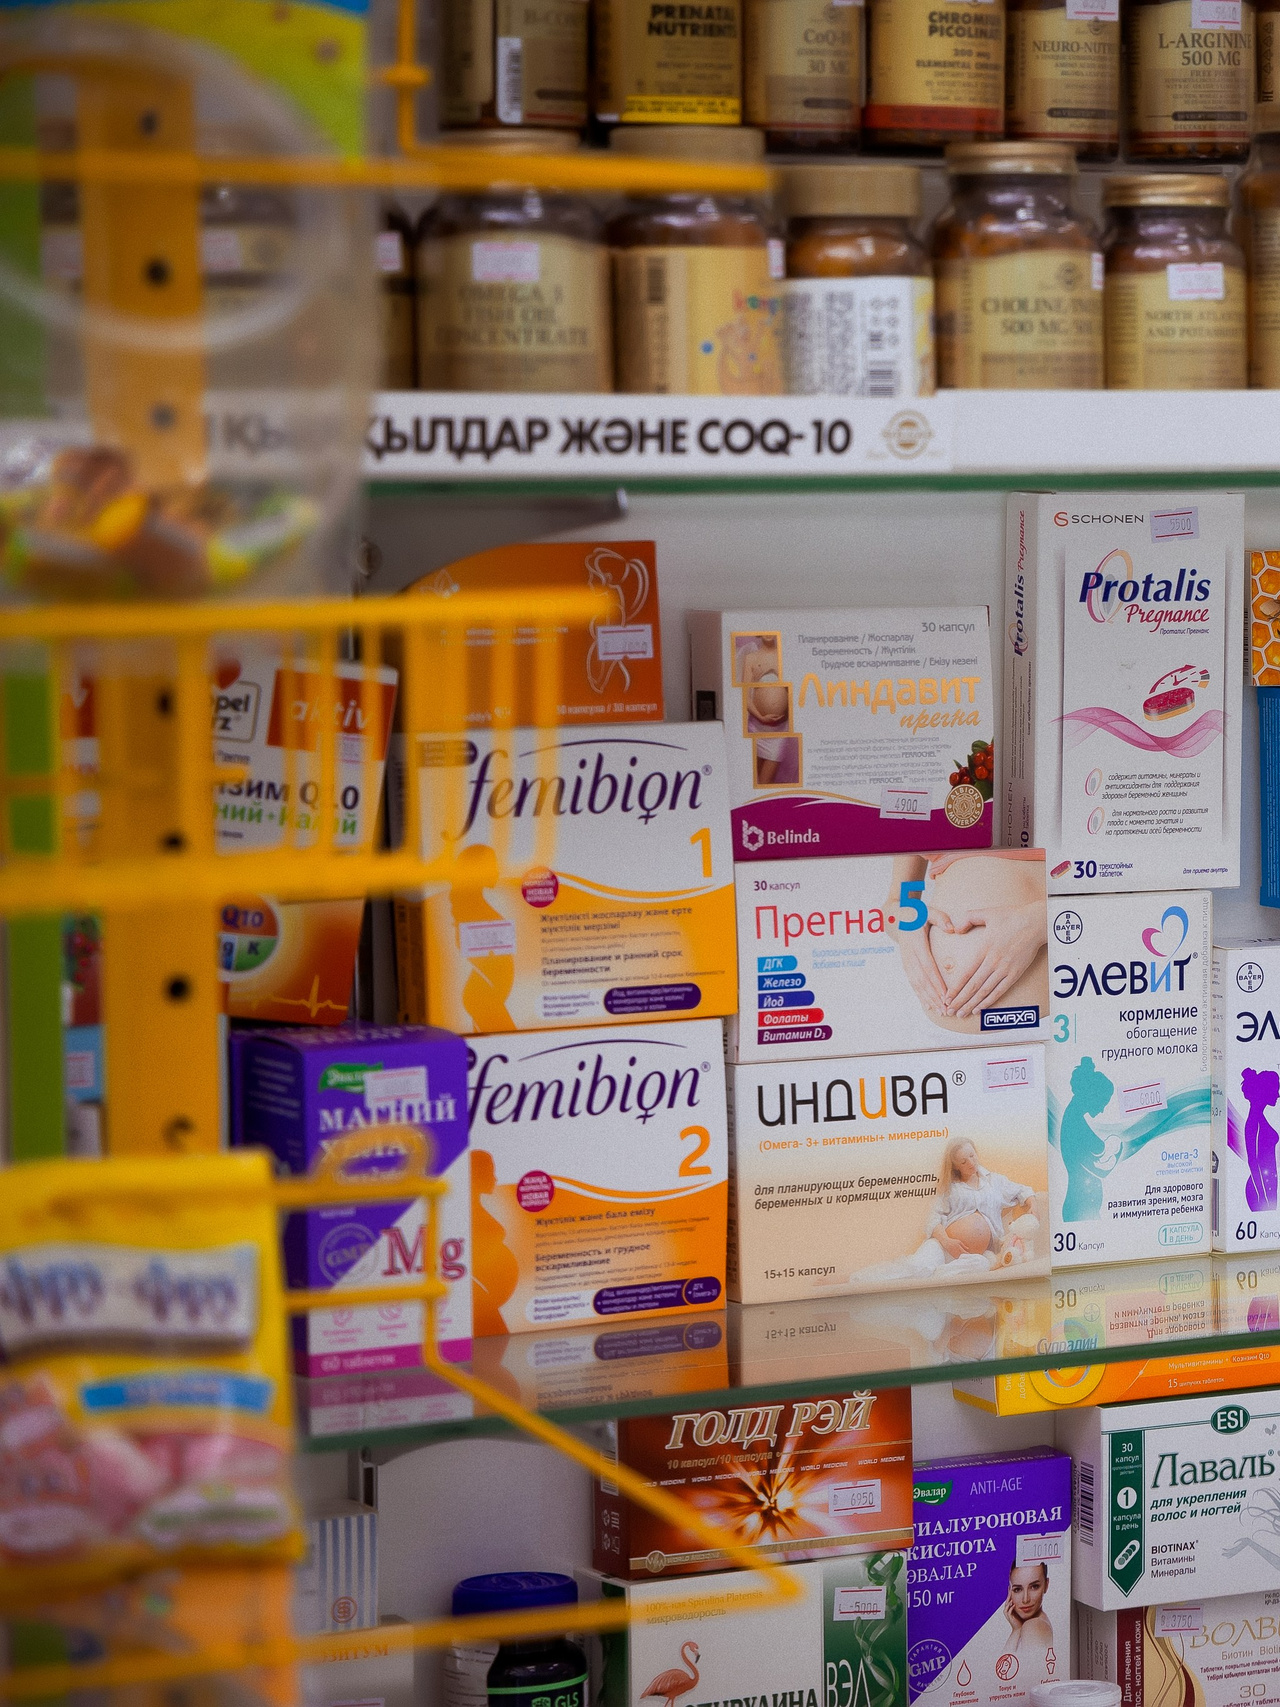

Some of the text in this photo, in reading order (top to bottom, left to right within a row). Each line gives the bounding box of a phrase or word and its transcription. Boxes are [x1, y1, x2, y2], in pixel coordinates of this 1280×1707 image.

[560, 418, 688, 455] ЖӘНЕ
[1071, 514, 1144, 524] SCHONEN
[1169, 518, 1192, 531] 5500
[1079, 568, 1210, 604] Protalis
[1124, 602, 1210, 633] Pregnance
[921, 622, 975, 634] 30 капсул
[798, 634, 858, 644] Планирование
[811, 647, 873, 656] Беременность
[798, 673, 981, 715] Линдавит
[900, 706, 981, 735] прегна
[441, 749, 702, 841] femibion
[894, 798, 918, 813] 4900
[767, 830, 820, 845] Belinda
[690, 827, 713, 877] 1
[1073, 860, 1097, 879] 30
[755, 906, 885, 948] Прегна
[763, 958, 784, 971] ДГК
[763, 976, 802, 988] Железо
[763, 994, 784, 1007] Йод
[763, 1012, 810, 1025] Фолаты
[1119, 1006, 1198, 1023] кормление
[1127, 1024, 1198, 1039] обогащение
[1101, 1042, 1198, 1061] грудного молока
[1003, 1066, 1026, 1081] 6750
[467, 1054, 700, 1130] femibion
[757, 1072, 949, 1127] ИНДИВА
[678, 1125, 712, 1177] 2
[1161, 1150, 1199, 1162] Омега-3
[754, 1172, 941, 1197] для планирующих беременность,
[1236, 1220, 1257, 1241] 60
[1053, 1232, 1105, 1253] 30 Капсул
[764, 1265, 836, 1280] 15+15 капсул
[666, 1389, 877, 1451] ГОЛД РЭЙ
[1217, 1410, 1244, 1429] ESI
[1152, 1453, 1275, 1488] Лаваль
[970, 1477, 1023, 1496] ANTI-AGE
[850, 1491, 874, 1507] 6950
[1150, 1489, 1246, 1511] для укрепления
[1150, 1503, 1241, 1523] волос и ногтей
[907, 1537, 997, 1561] КИСЛОТА
[1151, 1541, 1196, 1555] BIOTINAX
[1150, 1554, 1196, 1567] Витамины
[1150, 1566, 1196, 1579] Минералы
